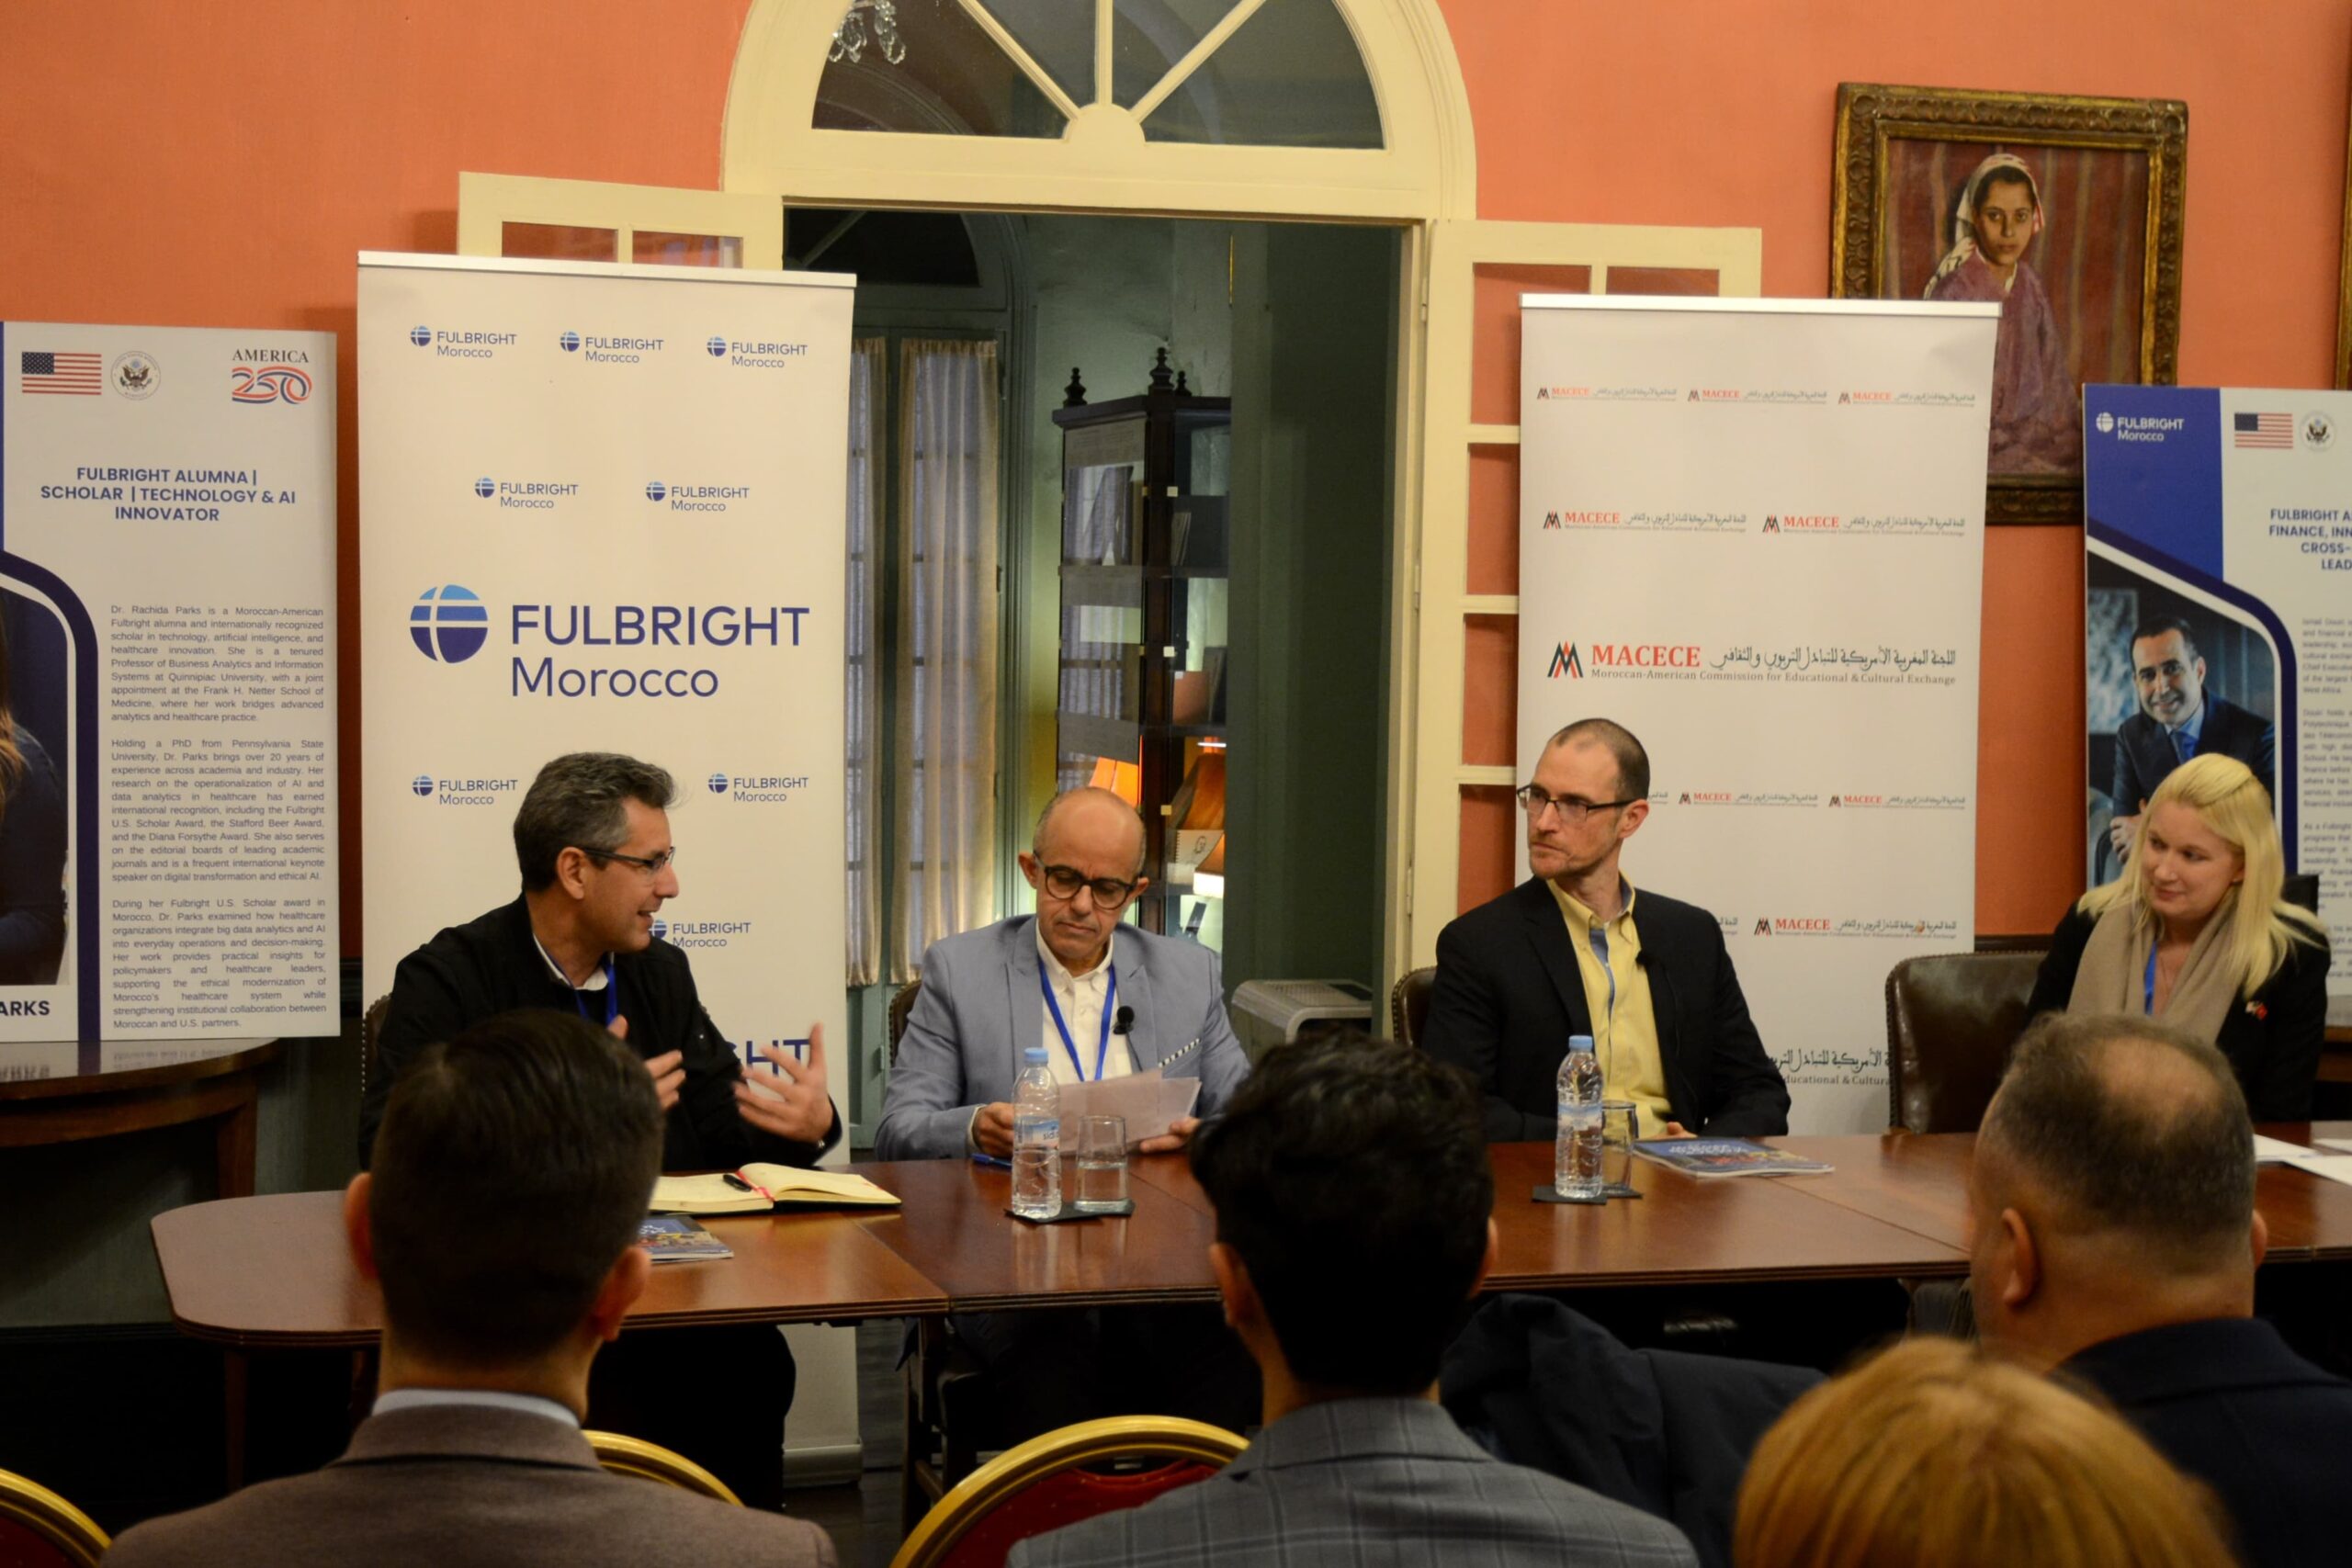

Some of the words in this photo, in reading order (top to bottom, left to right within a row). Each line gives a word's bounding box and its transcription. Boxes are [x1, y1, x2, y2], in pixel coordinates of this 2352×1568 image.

[437, 331, 517, 345] FULBRIGHT
[585, 336, 664, 351] FULBRIGHT
[437, 345, 492, 358] Morocco
[731, 342, 808, 356] FULBRIGHT
[232, 348, 310, 364] AMERICA
[585, 350, 639, 364] Morocco
[731, 355, 785, 368] Morocco
[1552, 387, 1589, 397] MACECE
[1702, 389, 1740, 399] MACECE
[1852, 391, 1891, 401] MACECE
[2117, 416, 2184, 431] FULBRIGHT
[2118, 429, 2165, 442] Morocco
[77, 467, 171, 482] FULBRIGHT
[175, 469, 248, 484] ALUMNA
[40, 486, 123, 501] SCHOLAR
[141, 487, 256, 503] TECHNOLOGY
[261, 491, 274, 504] &
[278, 491, 296, 504] AI
[500, 482, 579, 496] FULBRIGHT
[672, 486, 750, 499] FULBRIGHT
[500, 496, 554, 509] Morocco
[672, 500, 726, 512] Morocco
[115, 506, 220, 522] INNOVATOR
[1565, 512, 1621, 525] MACECE
[2270, 508, 2339, 521] FULBRIGHT
[1783, 515, 1839, 528] MACECE
[2269, 525, 2328, 539] FINANCE,
[131, 604, 168, 614] Rachida
[175, 605, 201, 615] Parks
[110, 618, 150, 629] Fulbright
[153, 619, 187, 627] alumna
[189, 619, 207, 627] and
[210, 619, 272, 630] internationally
[275, 621, 323, 631] recognized
[512, 604, 810, 648] FULBRIGHT
[110, 631, 143, 640] scholar
[147, 632, 155, 640] in
[213, 633, 247, 641] artificial
[307, 634, 323, 642] and
[110, 645, 158, 654] healthcare
[227, 646, 245, 655] She
[289, 647, 323, 655] tenured
[1591, 645, 1701, 668] MACECE
[110, 659, 153, 667] Professor
[156, 659, 165, 667] of
[168, 659, 209, 668] Business
[211, 660, 252, 670] Analytics
[254, 660, 271, 668] and
[274, 660, 323, 669] Information
[111, 671, 150, 682] Systems
[168, 672, 215, 683] Quinnipiac
[271, 673, 289, 682] with
[305, 674, 323, 683] joint
[512, 656, 718, 698] Morocco
[1591, 669, 1697, 680] Moroccan-American
[1700, 671, 1763, 682] Commission
[1766, 671, 1781, 682] for
[1785, 672, 1849, 682] Educational
[1860, 672, 1905, 683] Cultural
[1907, 673, 1956, 686] Exchange
[110, 685, 166, 695] appointment
[171, 686, 179, 694] at
[184, 685, 198, 694] the
[203, 685, 229, 694] Frank
[248, 686, 276, 694] Netter
[280, 686, 311, 694] School
[314, 686, 323, 694] of
[160, 699, 187, 707] where
[194, 699, 209, 707] her
[214, 699, 235, 707] work
[242, 699, 275, 710] bridges
[280, 700, 323, 708] advanced
[110, 712, 151, 722] analytics
[153, 712, 170, 720] and
[172, 712, 219, 720] healthcare
[111, 739, 145, 750] Holding
[172, 739, 191, 748] PhD
[201, 739, 221, 747] from
[232, 739, 290, 750] Pennsylvania
[300, 739, 323, 748] State
[439, 779, 518, 792] FULBRIGHT
[733, 776, 808, 790] FULBRIGHT
[439, 794, 494, 806] Morocco
[733, 790, 786, 802] Morocco
[1693, 792, 1732, 802] MACECE
[1843, 795, 1883, 804] MACECE
[673, 922, 752, 934] FULBRIGHT
[1775, 919, 1830, 931] MACECE
[673, 937, 727, 947] Morocco
[140, 952, 162, 961] work
[172, 952, 210, 962] provides
[220, 952, 258, 962] practical
[269, 951, 303, 961] insights
[313, 951, 325, 959] for
[112, 965, 171, 976] policymakers
[189, 964, 207, 974] and
[225, 964, 272, 973] healthcare
[112, 979, 160, 989] supporting
[200, 978, 230, 987] ethical
[242, 977, 305, 987] modernization
[317, 976, 326, 985] of
[113, 1006, 174, 1017] strengthening
[176, 1005, 227, 1014] institutional
[230, 1004, 287, 1013] collaboration
[288, 1004, 326, 1012] between
[113, 1020, 157, 1029] Moroccan
[1784, 1075, 1838, 1084] ducational
